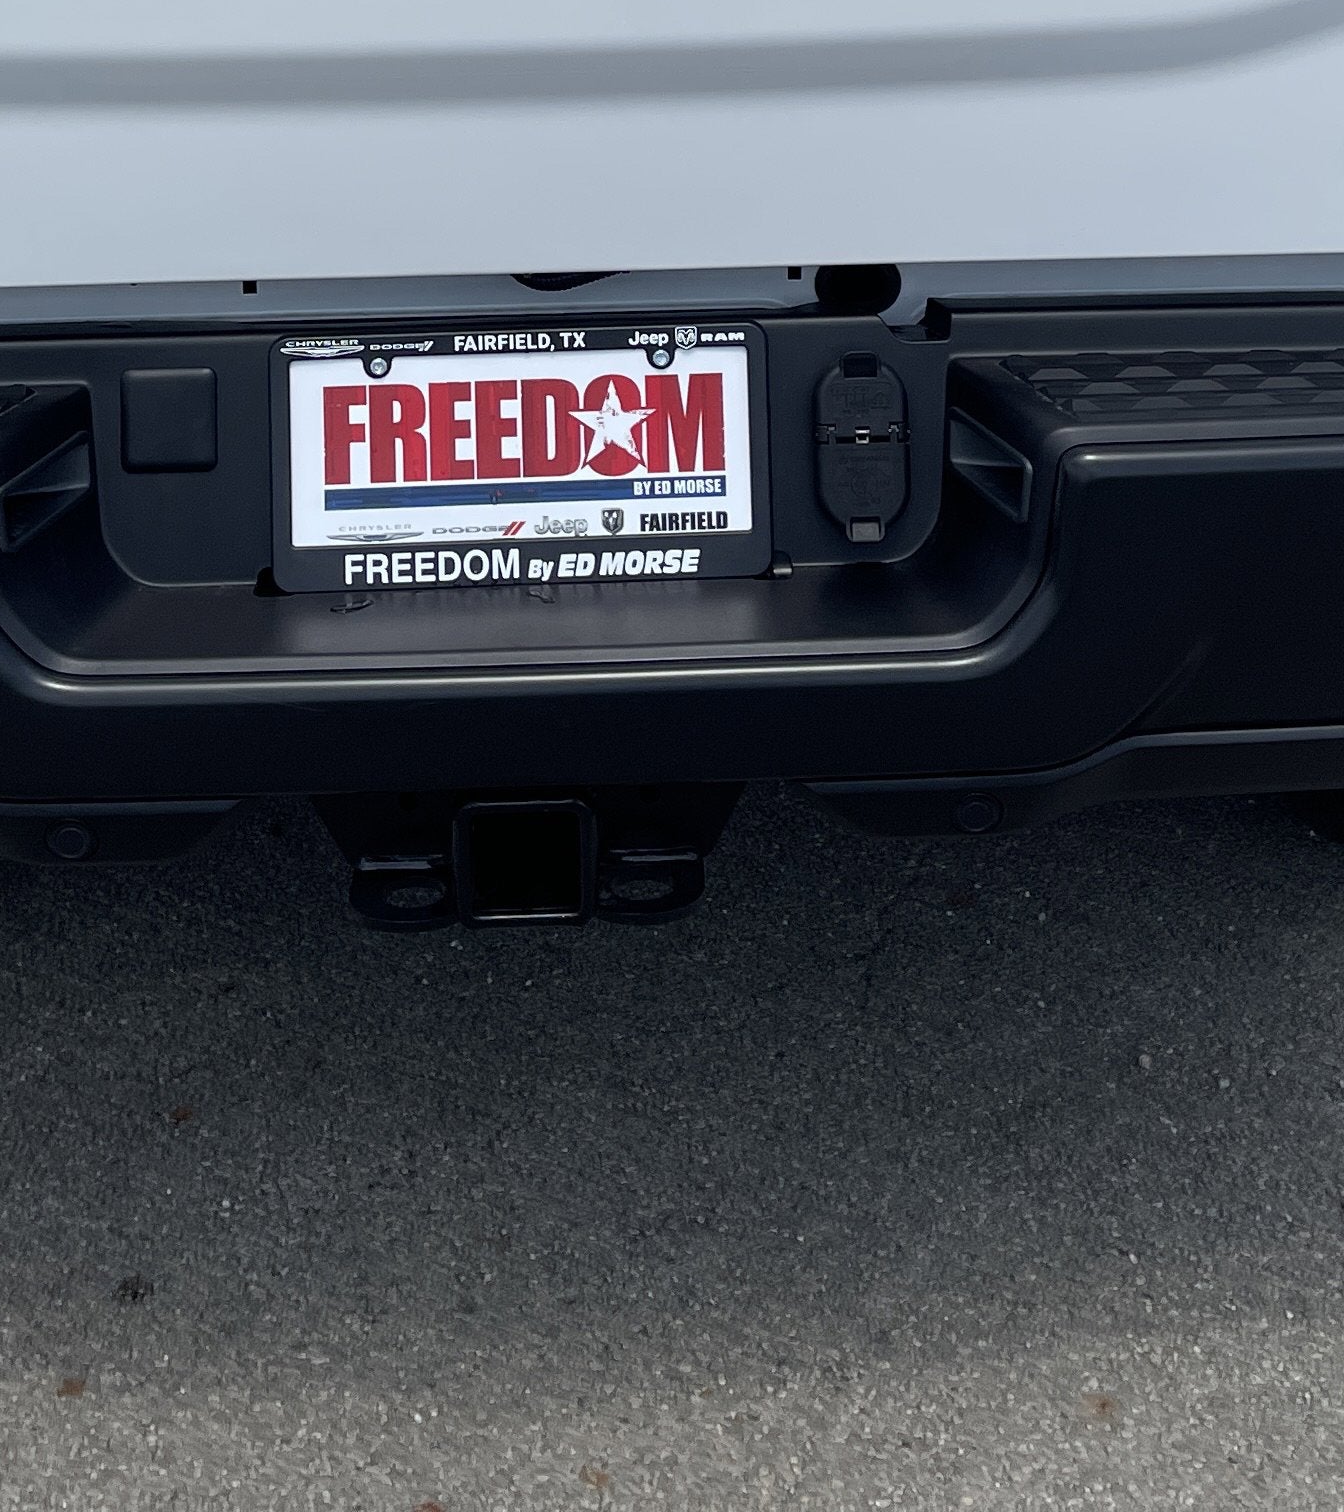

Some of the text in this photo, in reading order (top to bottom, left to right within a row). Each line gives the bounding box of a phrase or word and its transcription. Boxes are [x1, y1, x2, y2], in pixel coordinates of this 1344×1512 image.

[285, 339, 359, 348] CHRYSLER
[453, 332, 586, 352] FAIRFIELD, TX
[628, 331, 669, 347] Jeep
[700, 332, 745, 342] RAM
[322, 373, 726, 486] FREEDOM
[633, 478, 722, 496] BY ED MORSE
[338, 524, 412, 532] CHRYSLER
[534, 516, 588, 537] Jeep
[640, 511, 729, 532] FAIRFIELD
[345, 548, 702, 585] FREEDOM By ED MORSE
